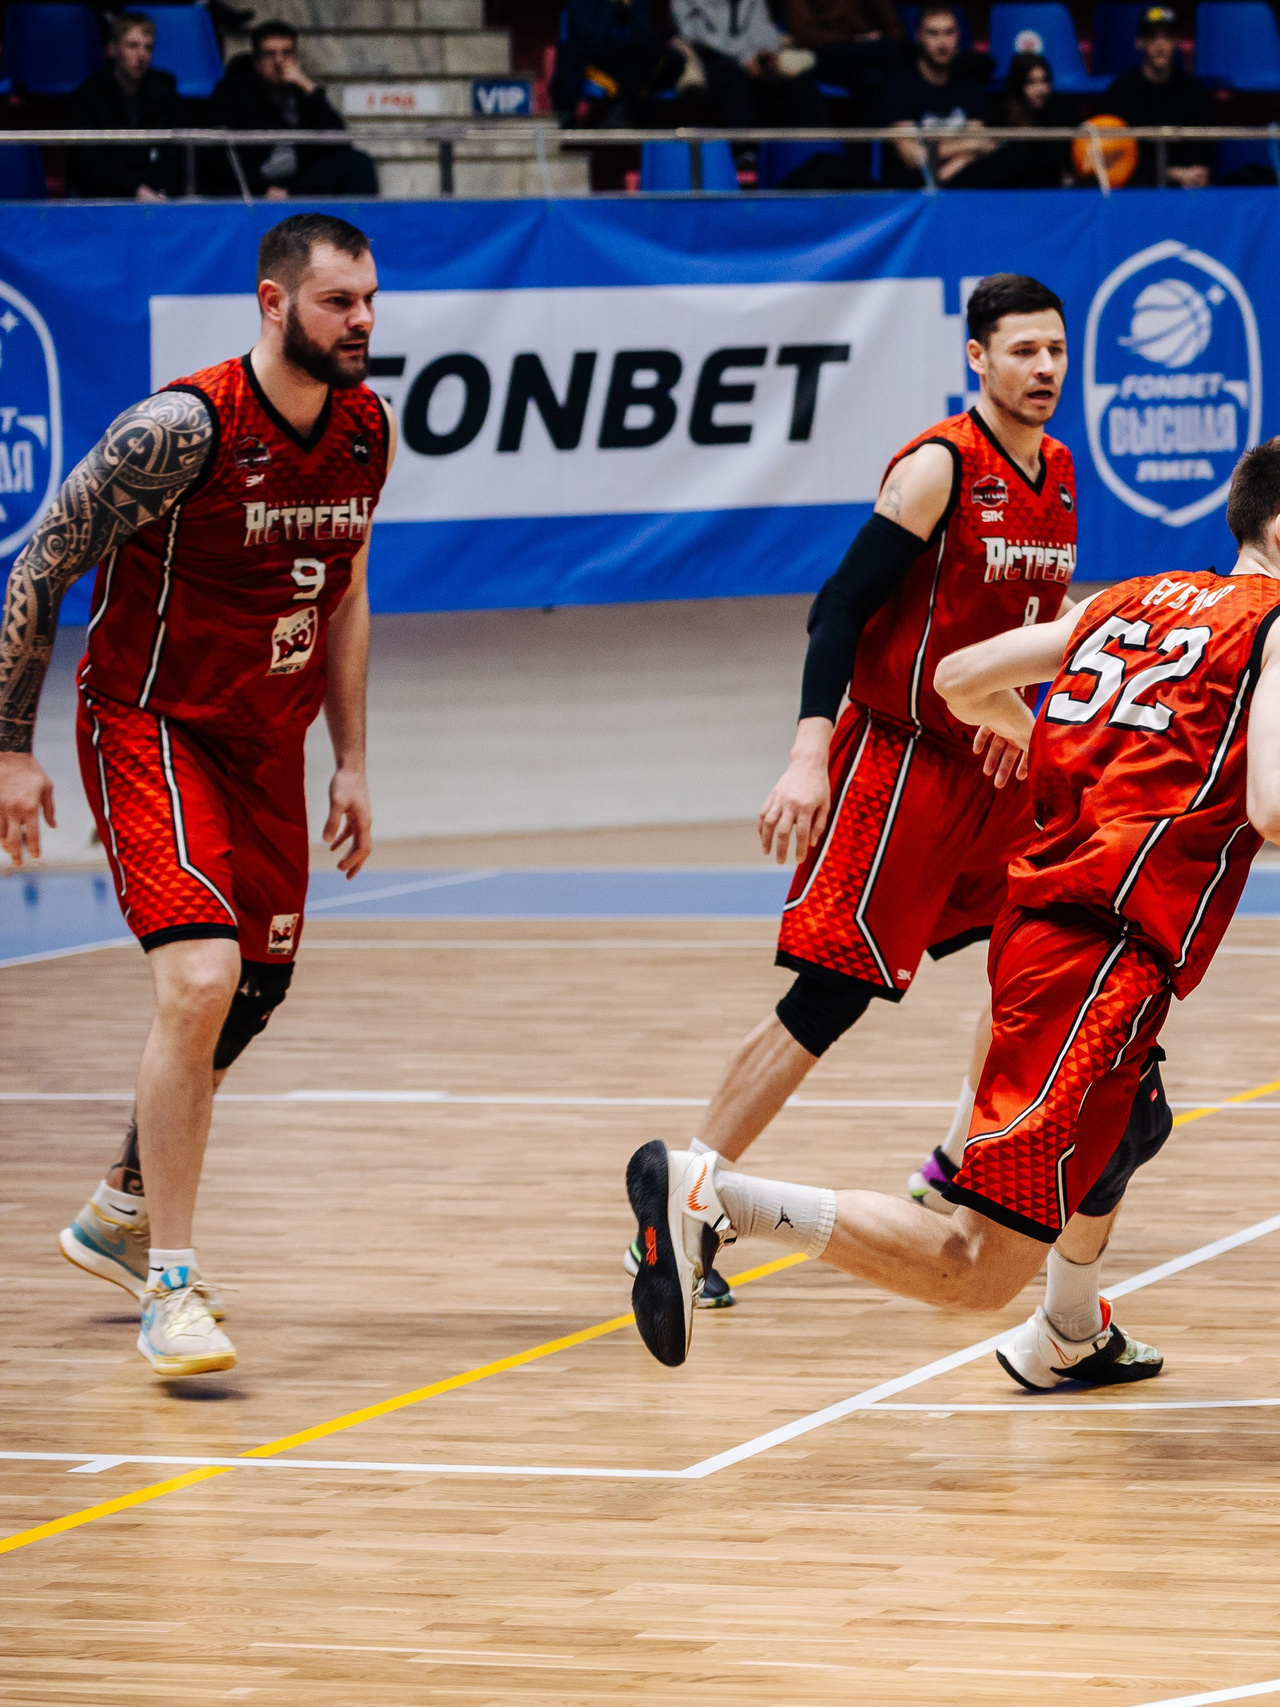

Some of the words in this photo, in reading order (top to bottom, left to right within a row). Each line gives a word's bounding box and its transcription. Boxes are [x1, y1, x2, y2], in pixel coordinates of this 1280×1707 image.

[477, 85, 525, 114] VIP
[1119, 372, 1226, 400] FONBET
[1108, 403, 1238, 456] ВЫСШАЯ
[1135, 458, 1215, 483] ЛИГА
[290, 558, 326, 600] 9
[1045, 614, 1212, 734] 52
